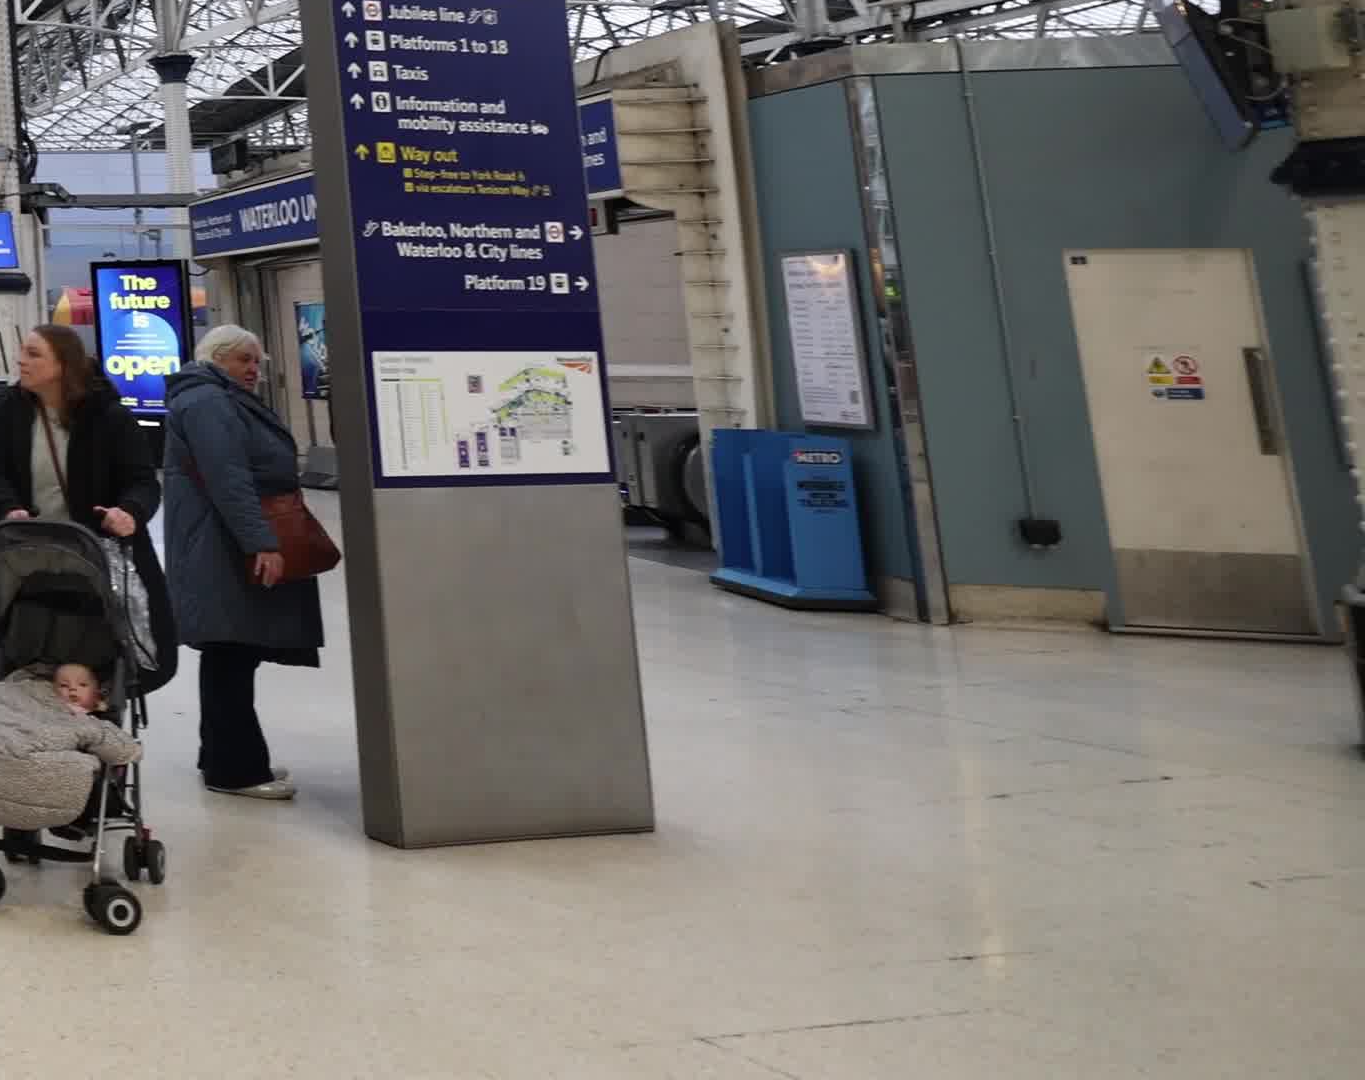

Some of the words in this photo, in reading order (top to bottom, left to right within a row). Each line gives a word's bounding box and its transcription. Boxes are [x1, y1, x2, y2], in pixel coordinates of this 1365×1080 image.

[387, 4, 438, 21] Jubilee
[439, 7, 466, 23] line
[389, 34, 458, 52] Platforms
[459, 38, 470, 53] 1
[471, 41, 487, 54] to
[490, 39, 509, 55] 18
[392, 65, 429, 81] Taxis
[395, 95, 478, 114] Information
[479, 99, 506, 115] and
[397, 116, 455, 135] mobility
[458, 119, 529, 135] assistance
[588, 127, 607, 146] and
[400, 146, 430, 165] Way
[433, 149, 459, 163] out
[238, 198, 300, 233] WATERLOO
[381, 221, 447, 240] Bakerloo,
[449, 223, 513, 240] Northern
[515, 224, 541, 240] and
[396, 242, 463, 259] Waterloo
[464, 243, 477, 258] &
[478, 242, 508, 262] City
[510, 244, 544, 260] lines
[119, 275, 158, 291] The
[464, 274, 525, 292] Platform
[527, 275, 546, 291] 19
[109, 292, 171, 310] future
[106, 355, 181, 381] open
[796, 452, 841, 464] METRO
